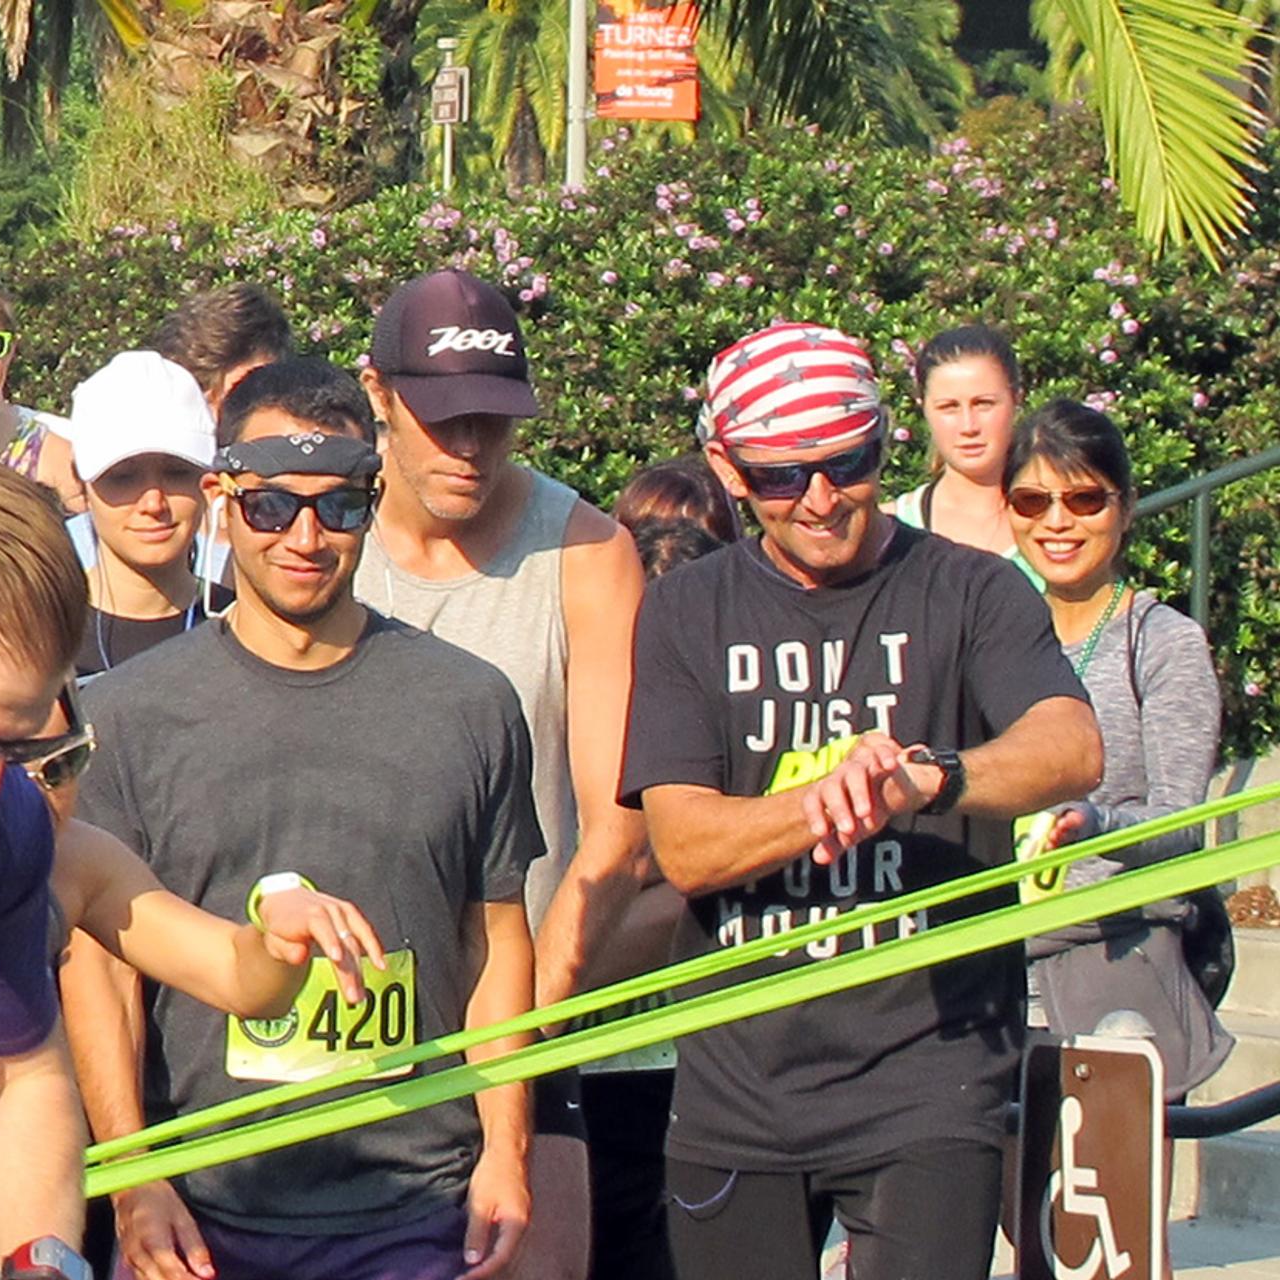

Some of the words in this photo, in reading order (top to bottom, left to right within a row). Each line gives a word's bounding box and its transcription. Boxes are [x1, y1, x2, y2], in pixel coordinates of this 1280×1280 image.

[598, 24, 691, 47] TURNER
[727, 632, 909, 693] DONT
[746, 694, 898, 752] JUST
[744, 839, 904, 897] OUR
[307, 977, 407, 1053] 420
